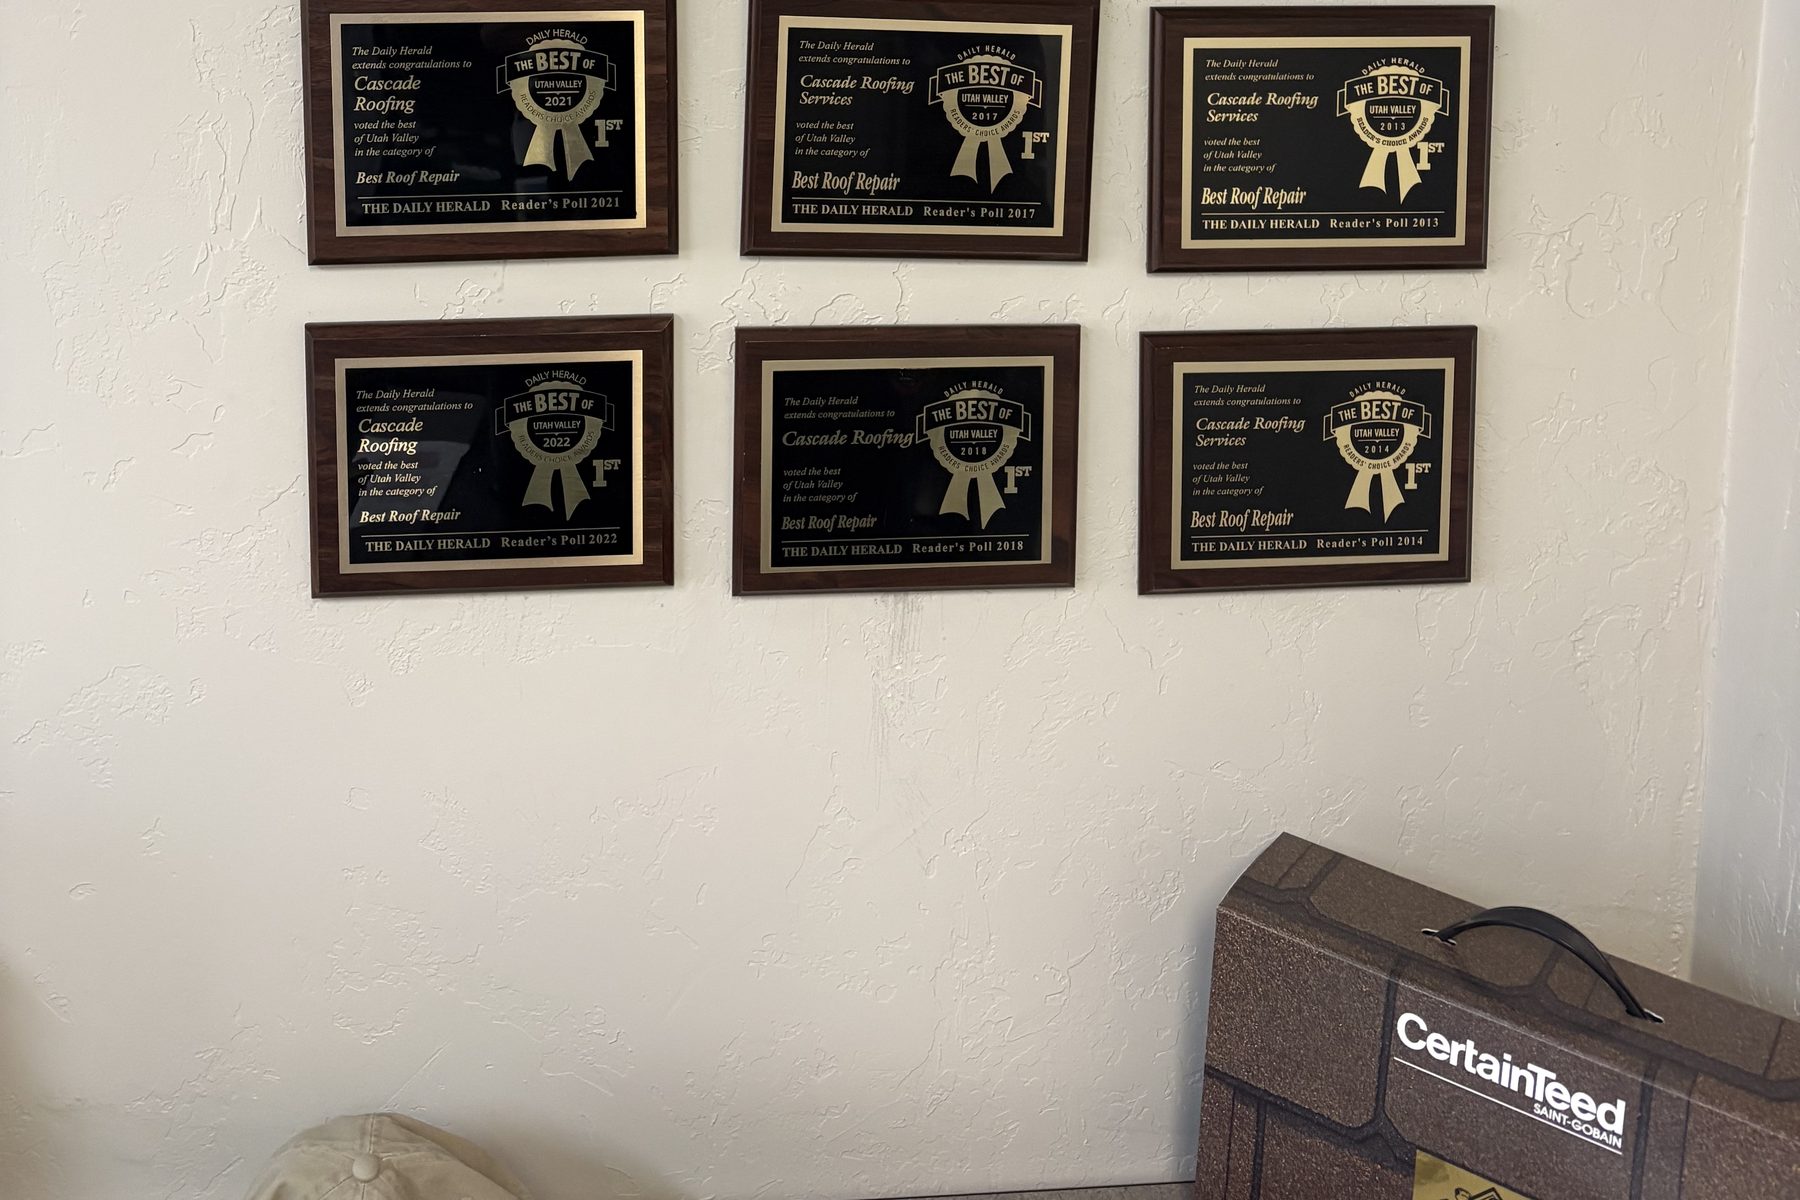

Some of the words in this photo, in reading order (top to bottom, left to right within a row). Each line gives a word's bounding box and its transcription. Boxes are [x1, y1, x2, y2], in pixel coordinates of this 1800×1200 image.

[354, 74, 421, 91] Cascade
[800, 74, 857, 89] Cascade
[859, 76, 915, 94] Roofing
[353, 95, 416, 115] Roofing
[799, 91, 853, 105] Services
[1207, 92, 1263, 106] Cascade
[1265, 91, 1319, 109] Roofing
[1206, 108, 1259, 122] Services
[361, 202, 390, 214] THE
[392, 201, 433, 213] DAILY
[436, 200, 490, 212] HERALD
[562, 197, 587, 208] Poll
[591, 196, 619, 208] 2021
[792, 203, 818, 214] THE
[821, 204, 859, 215] DAILY
[861, 204, 913, 216] HERALD
[923, 206, 975, 217] Reader's
[980, 207, 1003, 218] Poll
[1007, 208, 1035, 219] 2017
[1202, 219, 1227, 229] THE
[1230, 219, 1267, 229] DAILY
[1269, 218, 1320, 229] HERALD
[1330, 218, 1381, 228] Reader's
[1385, 217, 1408, 228] Poll
[1412, 217, 1439, 227] 2013
[358, 416, 423, 433] Cascade
[1196, 416, 1250, 430] Cascade
[1253, 416, 1306, 433] Roofing
[357, 436, 418, 456] Roofing
[782, 429, 848, 446] Cascade
[850, 428, 914, 449] Roofing
[1195, 433, 1247, 447] Services
[1190, 510, 1216, 528] Best
[1218, 508, 1251, 532] Roof
[1250, 508, 1294, 532] Repair
[365, 540, 392, 552] THE
[395, 539, 434, 551] DAILY
[437, 537, 490, 550] HERALD
[560, 534, 585, 545] Poll
[588, 532, 617, 544] 2022
[781, 546, 808, 557] THE
[811, 545, 849, 556] DAILY
[851, 544, 902, 555] HERALD
[912, 542, 964, 553] Reader's
[969, 541, 992, 552] Poll
[996, 540, 1023, 551] 2018
[1191, 541, 1216, 552] THE
[1219, 540, 1255, 551] DAILY
[1258, 539, 1307, 550] HERALD
[1316, 537, 1367, 548] Reader's
[1371, 536, 1393, 547] Poll
[1397, 536, 1423, 546] 2014
[1397, 1012, 1626, 1135] CertainTeed
[1533, 1102, 1622, 1149] SAINT-GOBAIN
